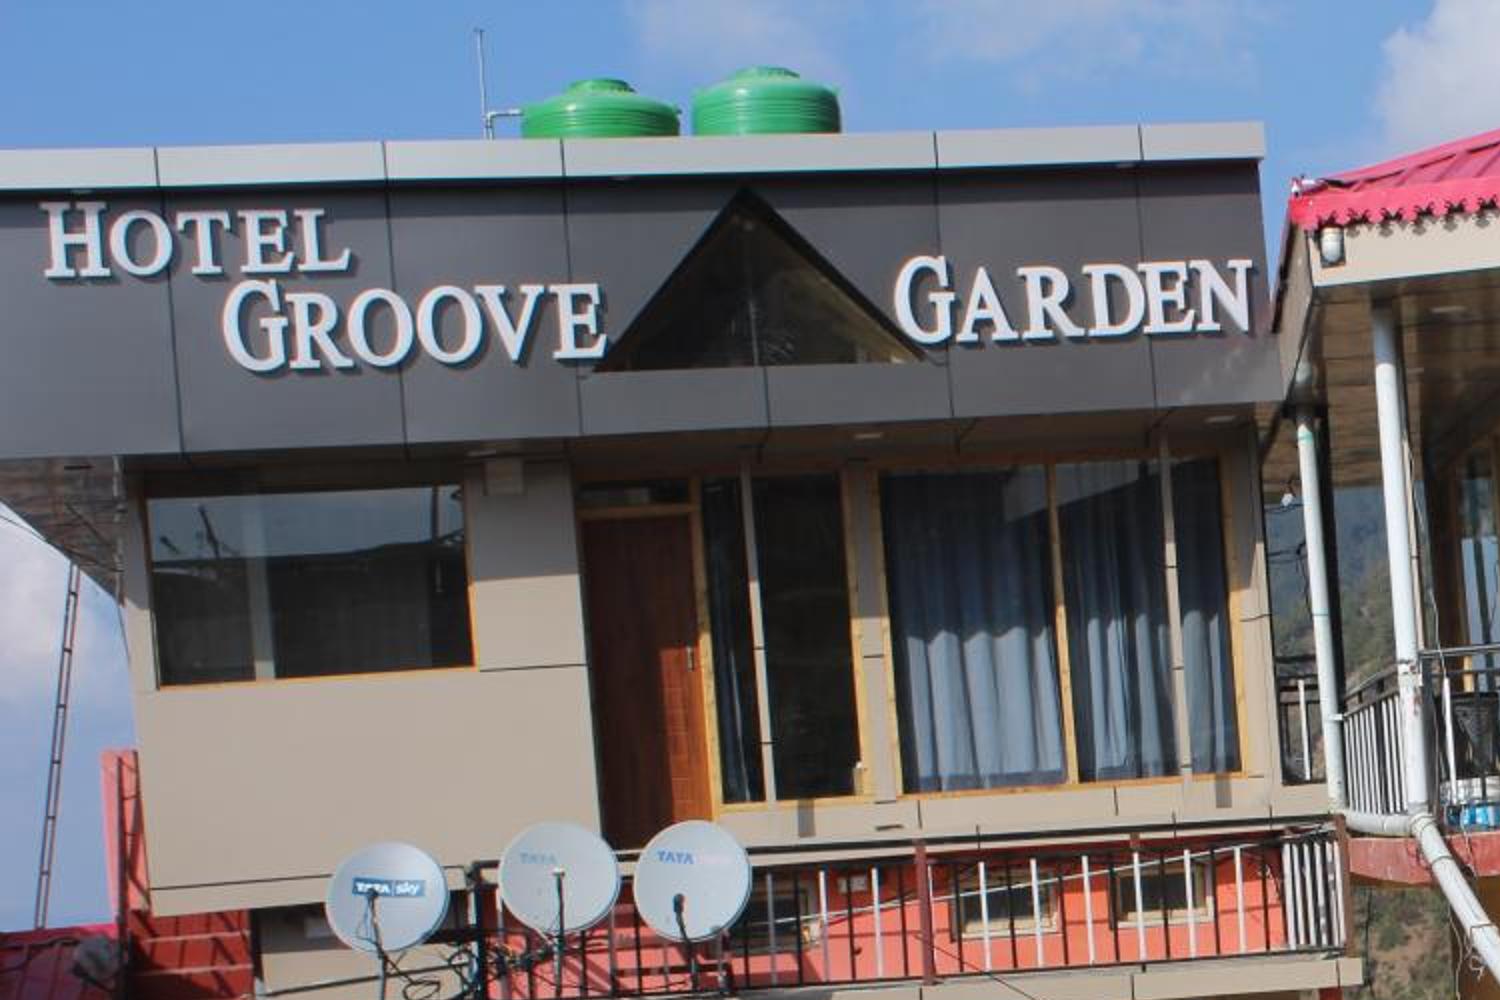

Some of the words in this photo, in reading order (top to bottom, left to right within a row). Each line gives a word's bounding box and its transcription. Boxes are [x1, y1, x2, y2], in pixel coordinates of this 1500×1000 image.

[41, 200, 351, 279] HOTEL
[222, 279, 608, 373] GROOVE
[893, 255, 1253, 346] GARDEN
[657, 850, 695, 865] TATA
